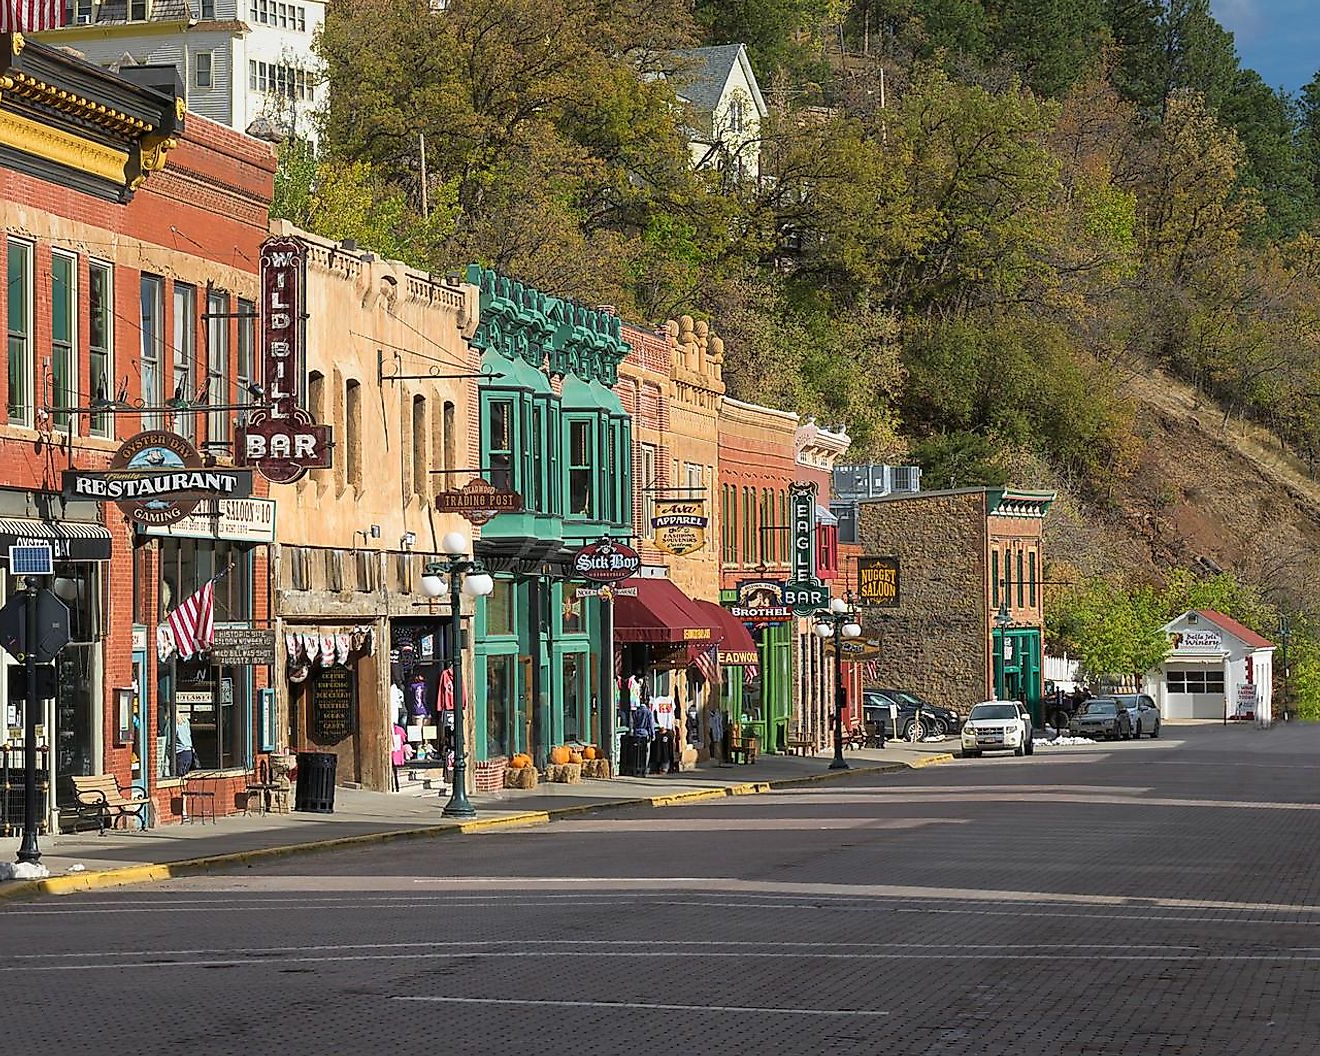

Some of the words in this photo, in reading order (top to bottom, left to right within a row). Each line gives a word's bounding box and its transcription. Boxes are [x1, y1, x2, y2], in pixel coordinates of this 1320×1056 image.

[270, 252, 293, 330] WILD
[270, 341, 290, 419] BILL
[122, 434, 167, 458] OYSTER
[171, 437, 193, 459] BAY
[246, 434, 318, 459] BAR
[75, 472, 237, 497] RESTAURANT
[463, 485, 495, 495] DEADWOOD
[445, 495, 485, 506] TRADING
[490, 495, 513, 506] POST
[133, 507, 181, 522] GAMING
[225, 500, 254, 523] SALOON
[261, 503, 271, 523] 10
[656, 516, 703, 526] APPAREL
[54, 539, 71, 557] BAY
[797, 504, 809, 582] EAGLE
[576, 553, 609, 571] Sick
[610, 553, 639, 571] Boy
[861, 569, 897, 585] NUGGET
[785, 591, 822, 604] BAR
[861, 583, 897, 597] SALOON
[731, 606, 791, 616] BROTHEL
[1185, 639, 1220, 649] Winery
